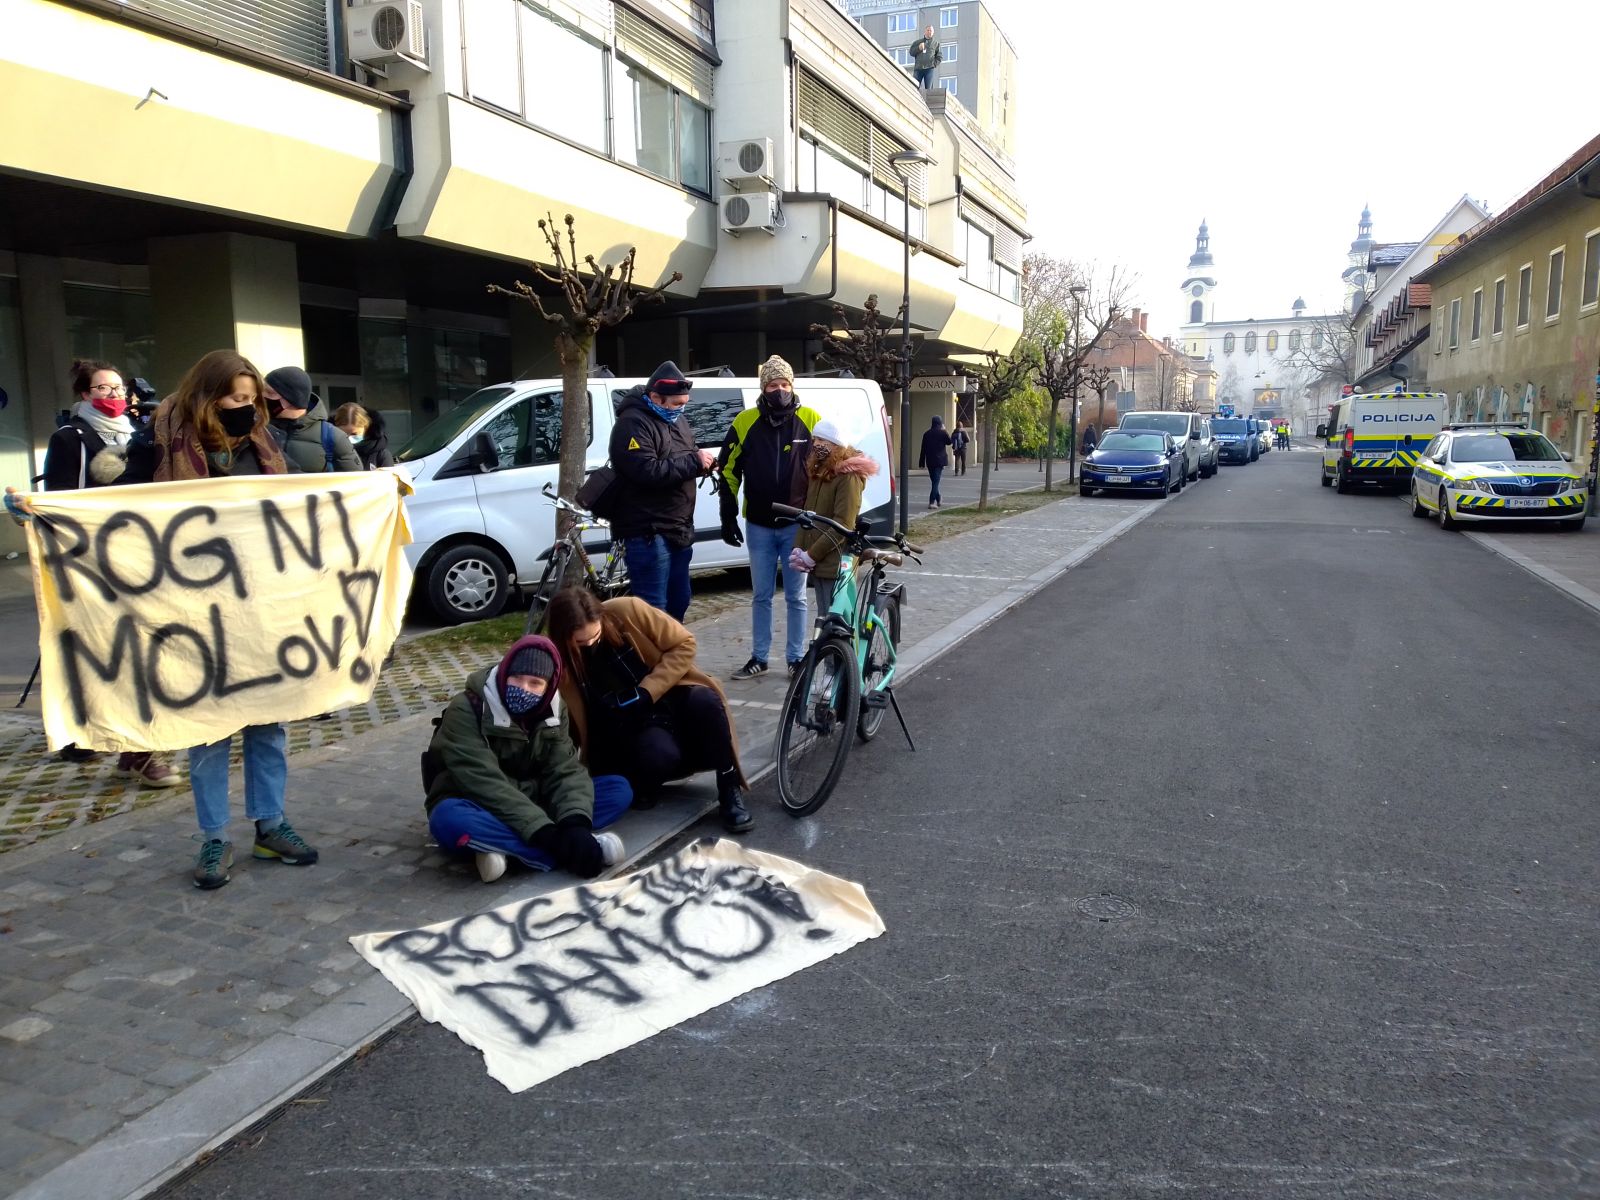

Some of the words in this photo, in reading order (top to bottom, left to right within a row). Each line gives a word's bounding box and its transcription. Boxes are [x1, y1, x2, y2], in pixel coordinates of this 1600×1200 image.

[918, 380, 956, 389] ONAON
[1362, 413, 1436, 423] POLICIJA
[33, 506, 248, 602] ROG
[261, 491, 360, 572] NI
